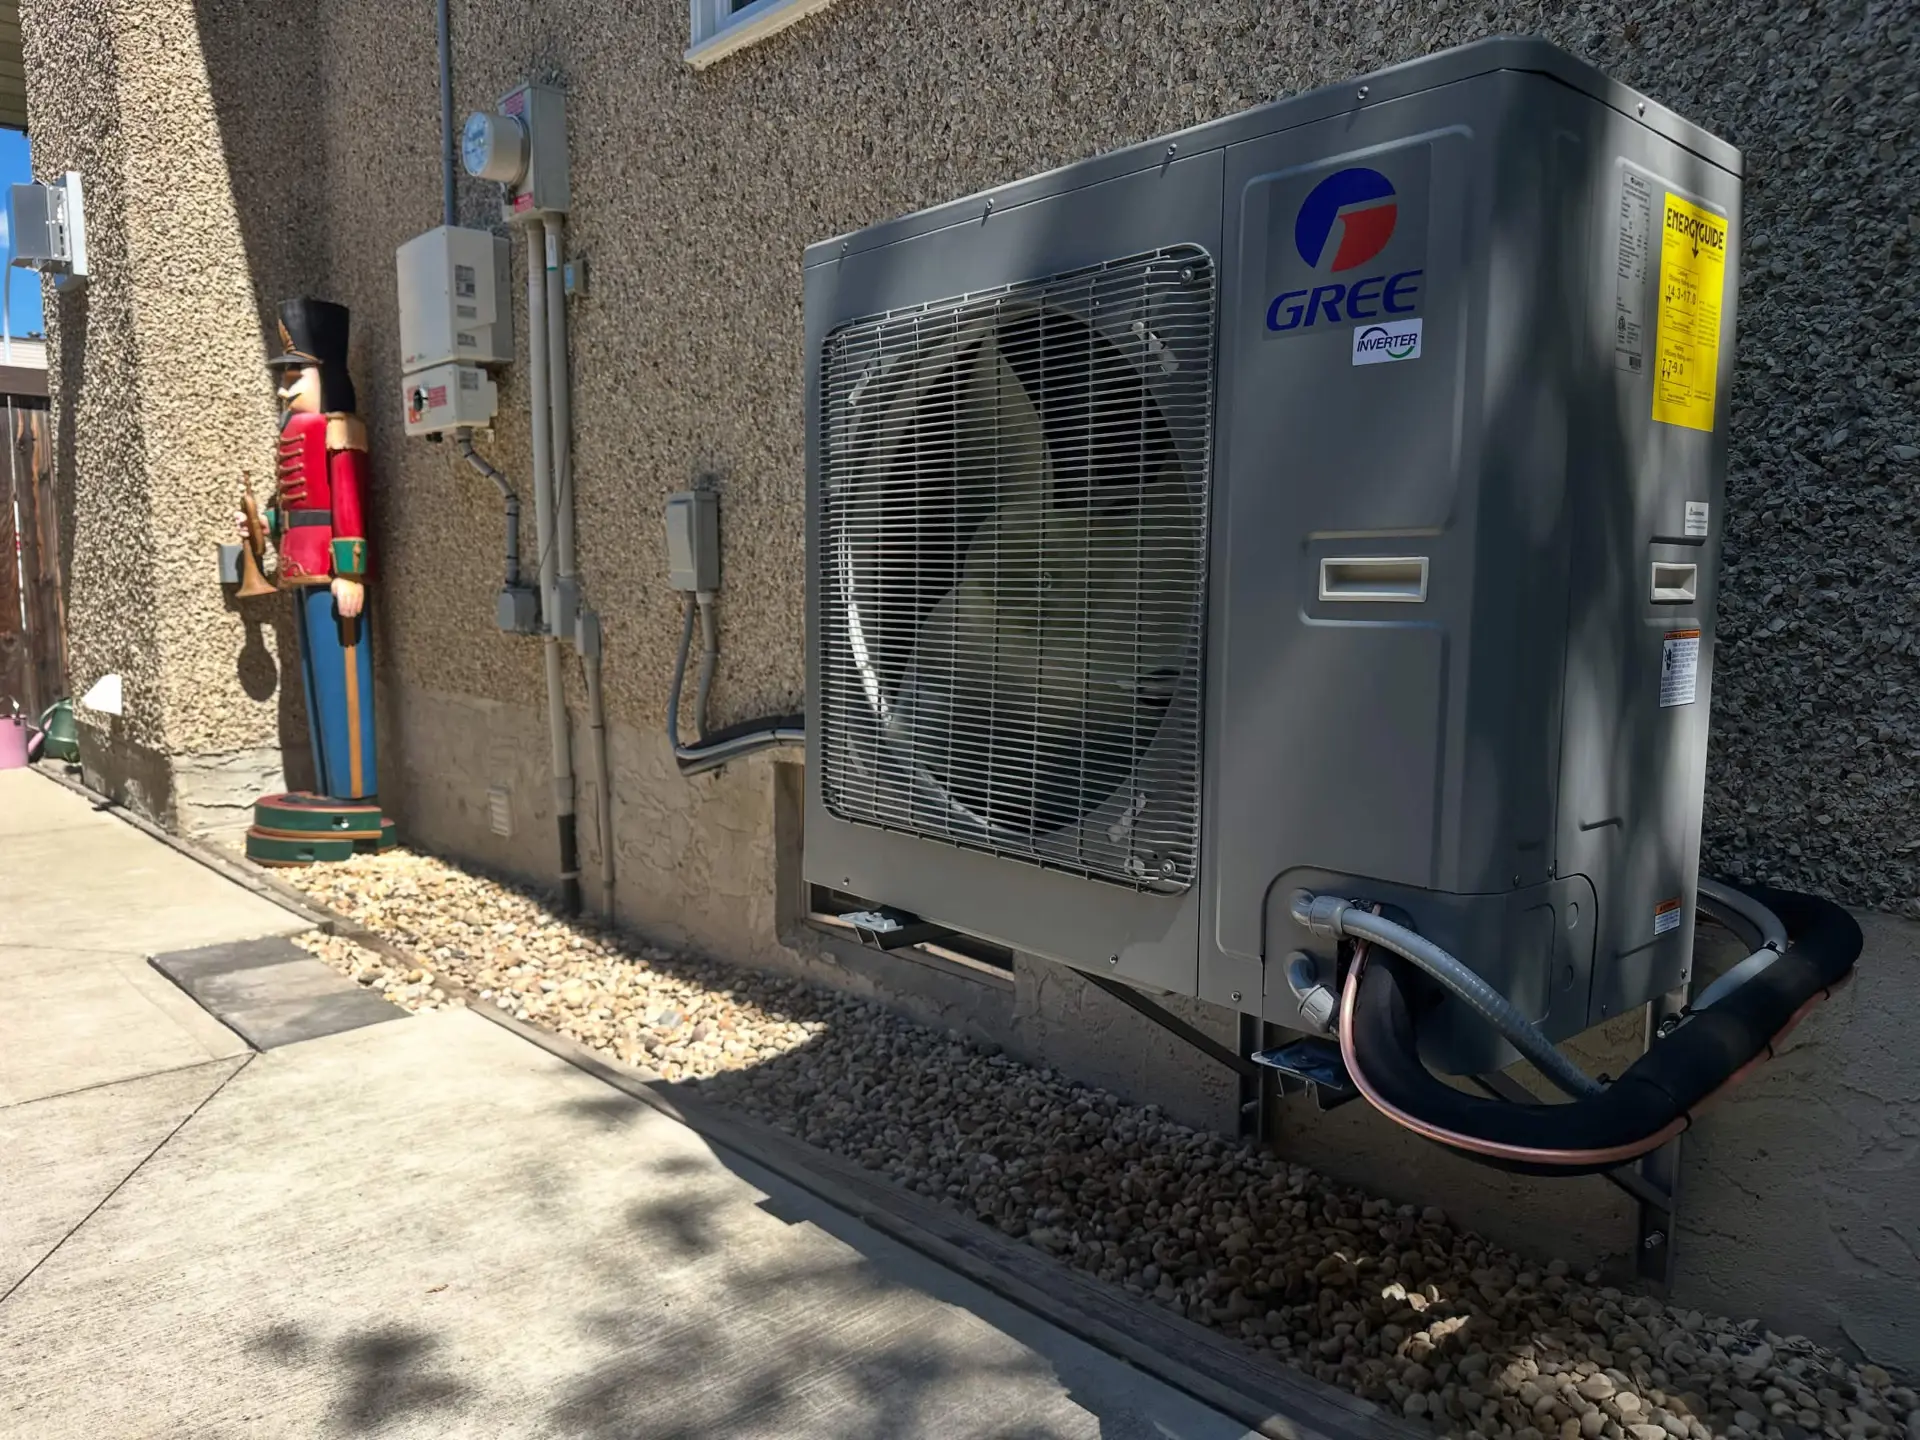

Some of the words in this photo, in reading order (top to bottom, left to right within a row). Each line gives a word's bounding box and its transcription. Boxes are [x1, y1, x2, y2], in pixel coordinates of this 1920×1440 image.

[1666, 208, 1724, 250] ENERGYGUIDE
[1266, 269, 1423, 331] GREE
[1357, 333, 1418, 352] INVERTER
